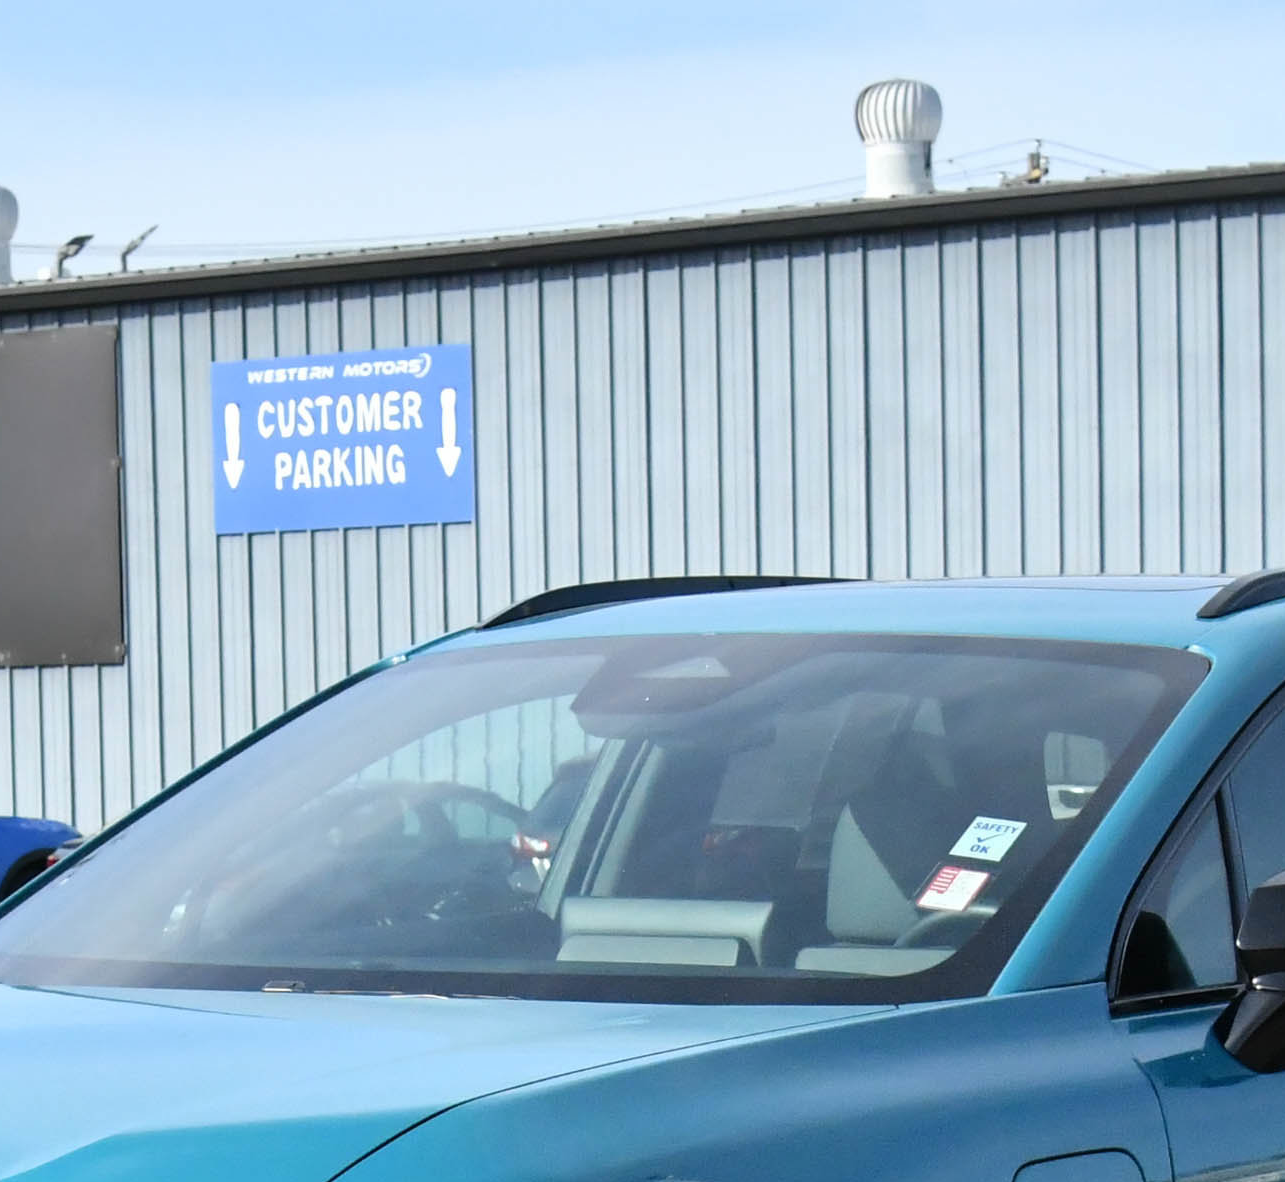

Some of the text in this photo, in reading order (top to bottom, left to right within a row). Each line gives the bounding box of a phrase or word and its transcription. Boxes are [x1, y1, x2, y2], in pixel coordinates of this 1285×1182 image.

[247, 358, 421, 384] WESTERN MOTORS
[257, 390, 423, 440] CUSTOMER
[274, 443, 407, 491] PARKING
[974, 822, 1019, 834] SAFETY
[970, 844, 991, 854] OK
